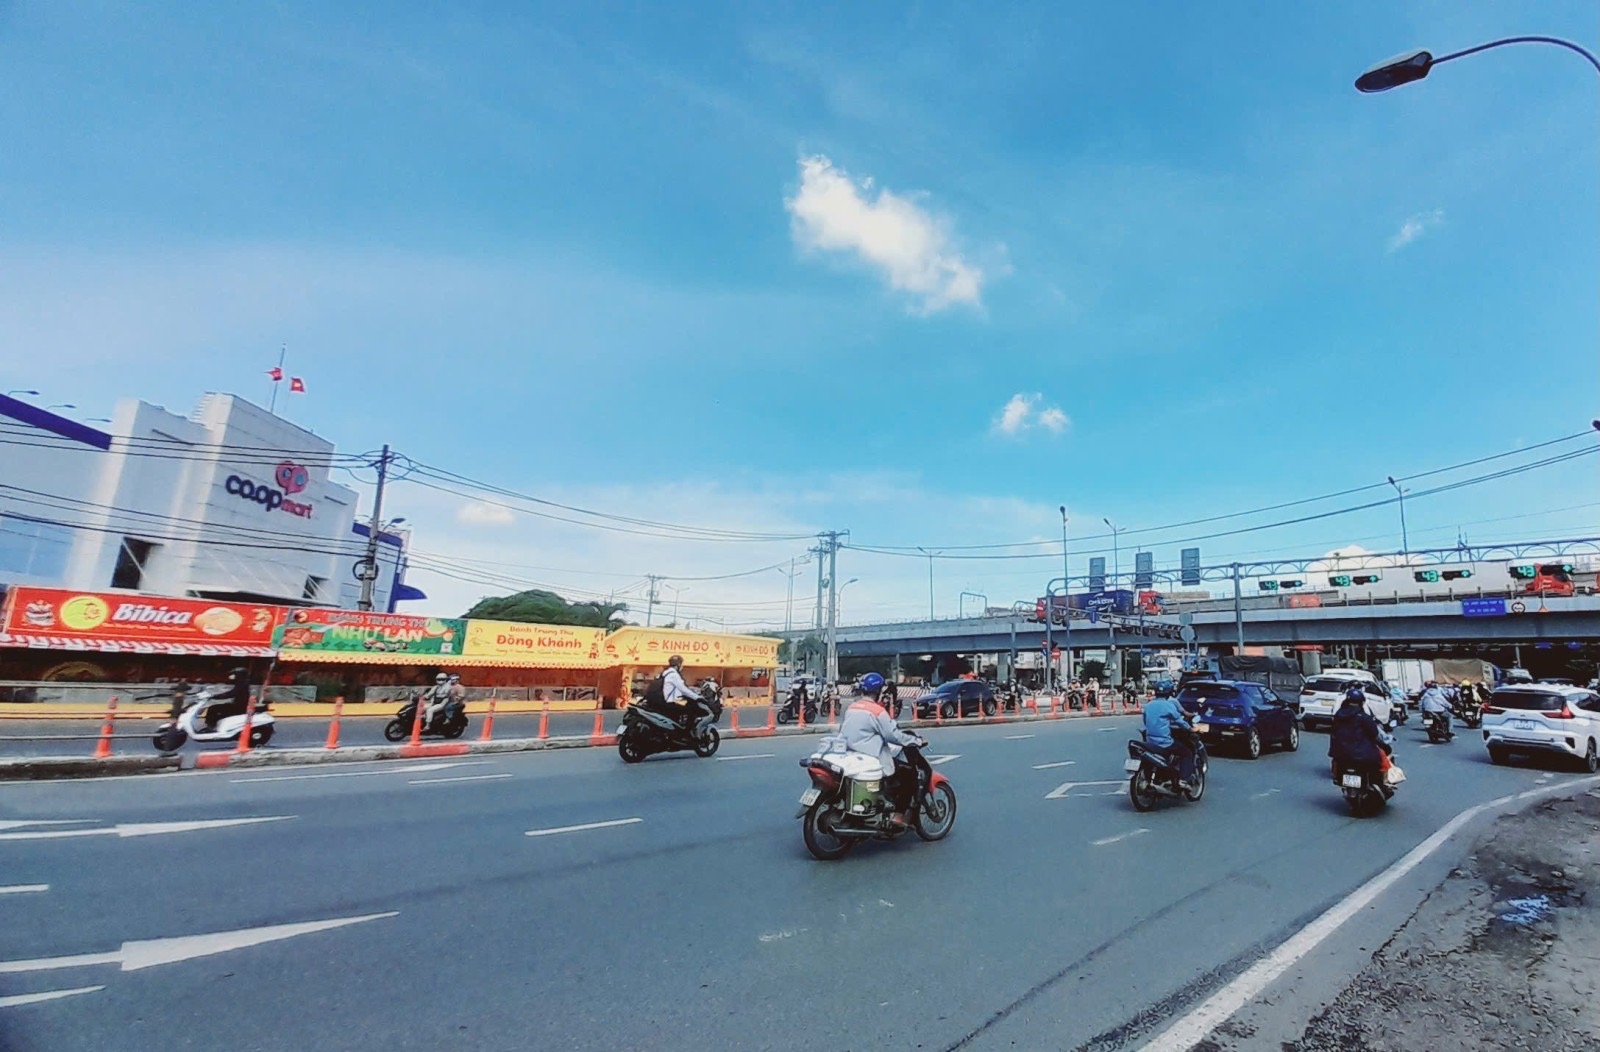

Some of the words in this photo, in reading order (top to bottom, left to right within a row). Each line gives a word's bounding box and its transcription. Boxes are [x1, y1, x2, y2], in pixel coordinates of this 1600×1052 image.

[1422, 570, 1438, 582] 43
[1517, 565, 1535, 578] 43
[1264, 580, 1278, 591] 43
[1335, 575, 1350, 587] 43
[112, 603, 193, 624] Bibica
[365, 615, 406, 627] TRUNG
[332, 624, 382, 641] NHƯ
[383, 627, 423, 642] LAN
[534, 627, 558, 636] Trung
[496, 634, 534, 648] Đồng
[538, 636, 582, 649] Khánh
[662, 639, 690, 651] KINH
[692, 639, 709, 652] ĐÔ
